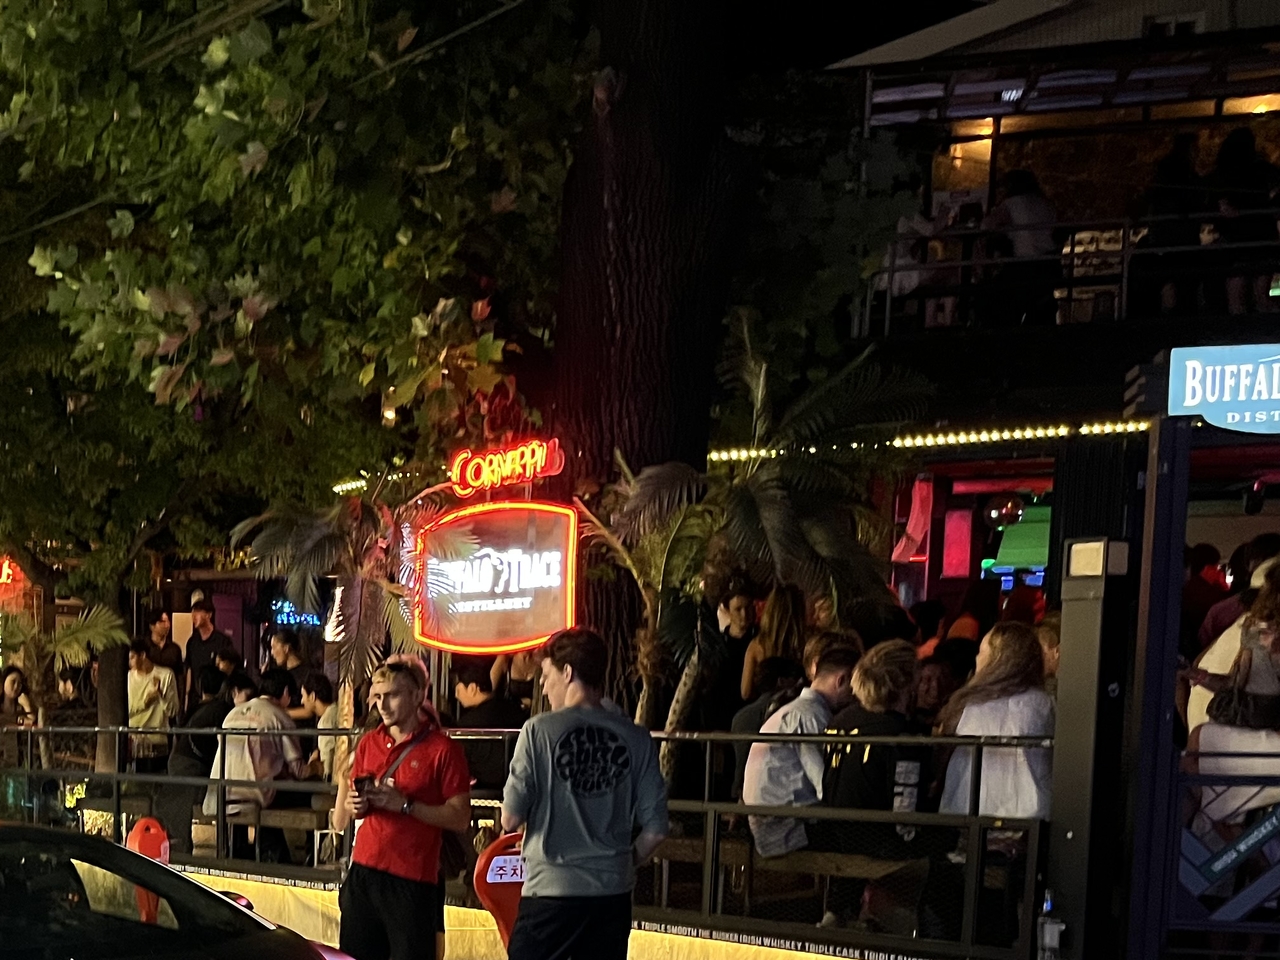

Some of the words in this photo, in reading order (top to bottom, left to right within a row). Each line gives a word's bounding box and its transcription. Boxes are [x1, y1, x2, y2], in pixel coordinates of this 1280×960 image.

[641, 921, 665, 932] TRIPLE
[667, 925, 697, 937] SMOOTH
[698, 929, 711, 938] THE
[712, 931, 738, 942] BUSKER
[740, 934, 762, 946] IRISH
[763, 937, 802, 950] WHISKEY
[805, 942, 834, 956] TRIPLE
[836, 946, 860, 959] CASK
